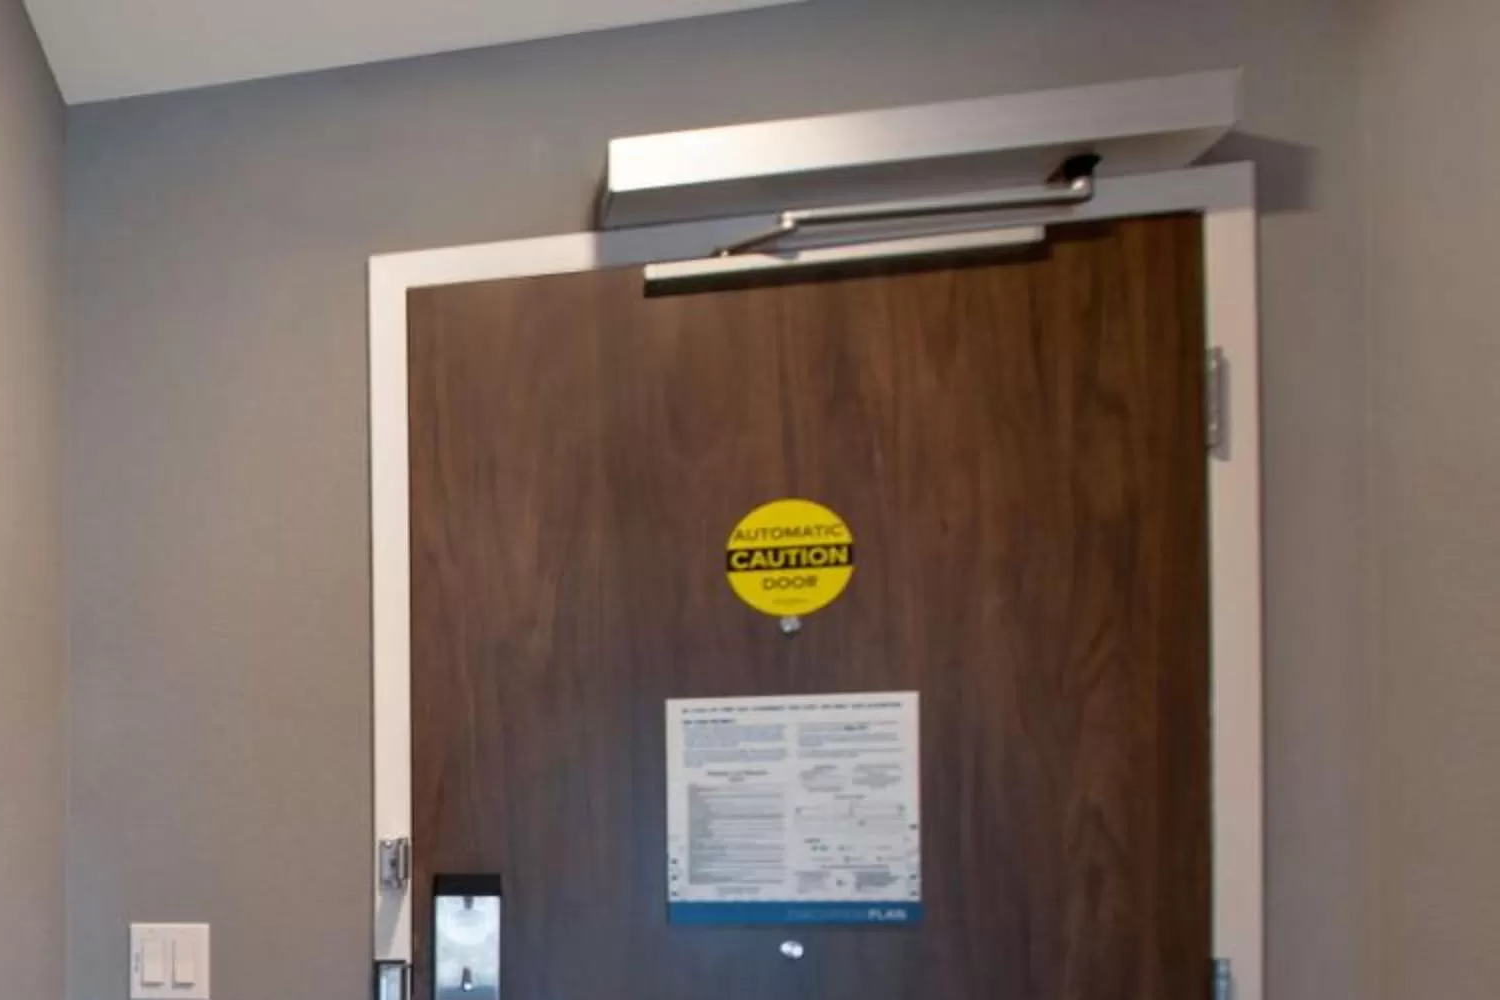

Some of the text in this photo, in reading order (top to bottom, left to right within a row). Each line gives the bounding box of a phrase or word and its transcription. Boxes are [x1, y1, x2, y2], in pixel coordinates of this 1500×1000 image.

[733, 523, 845, 542] AUTOMATIC
[729, 547, 848, 570] CAUTION
[762, 574, 819, 591] DOOR
